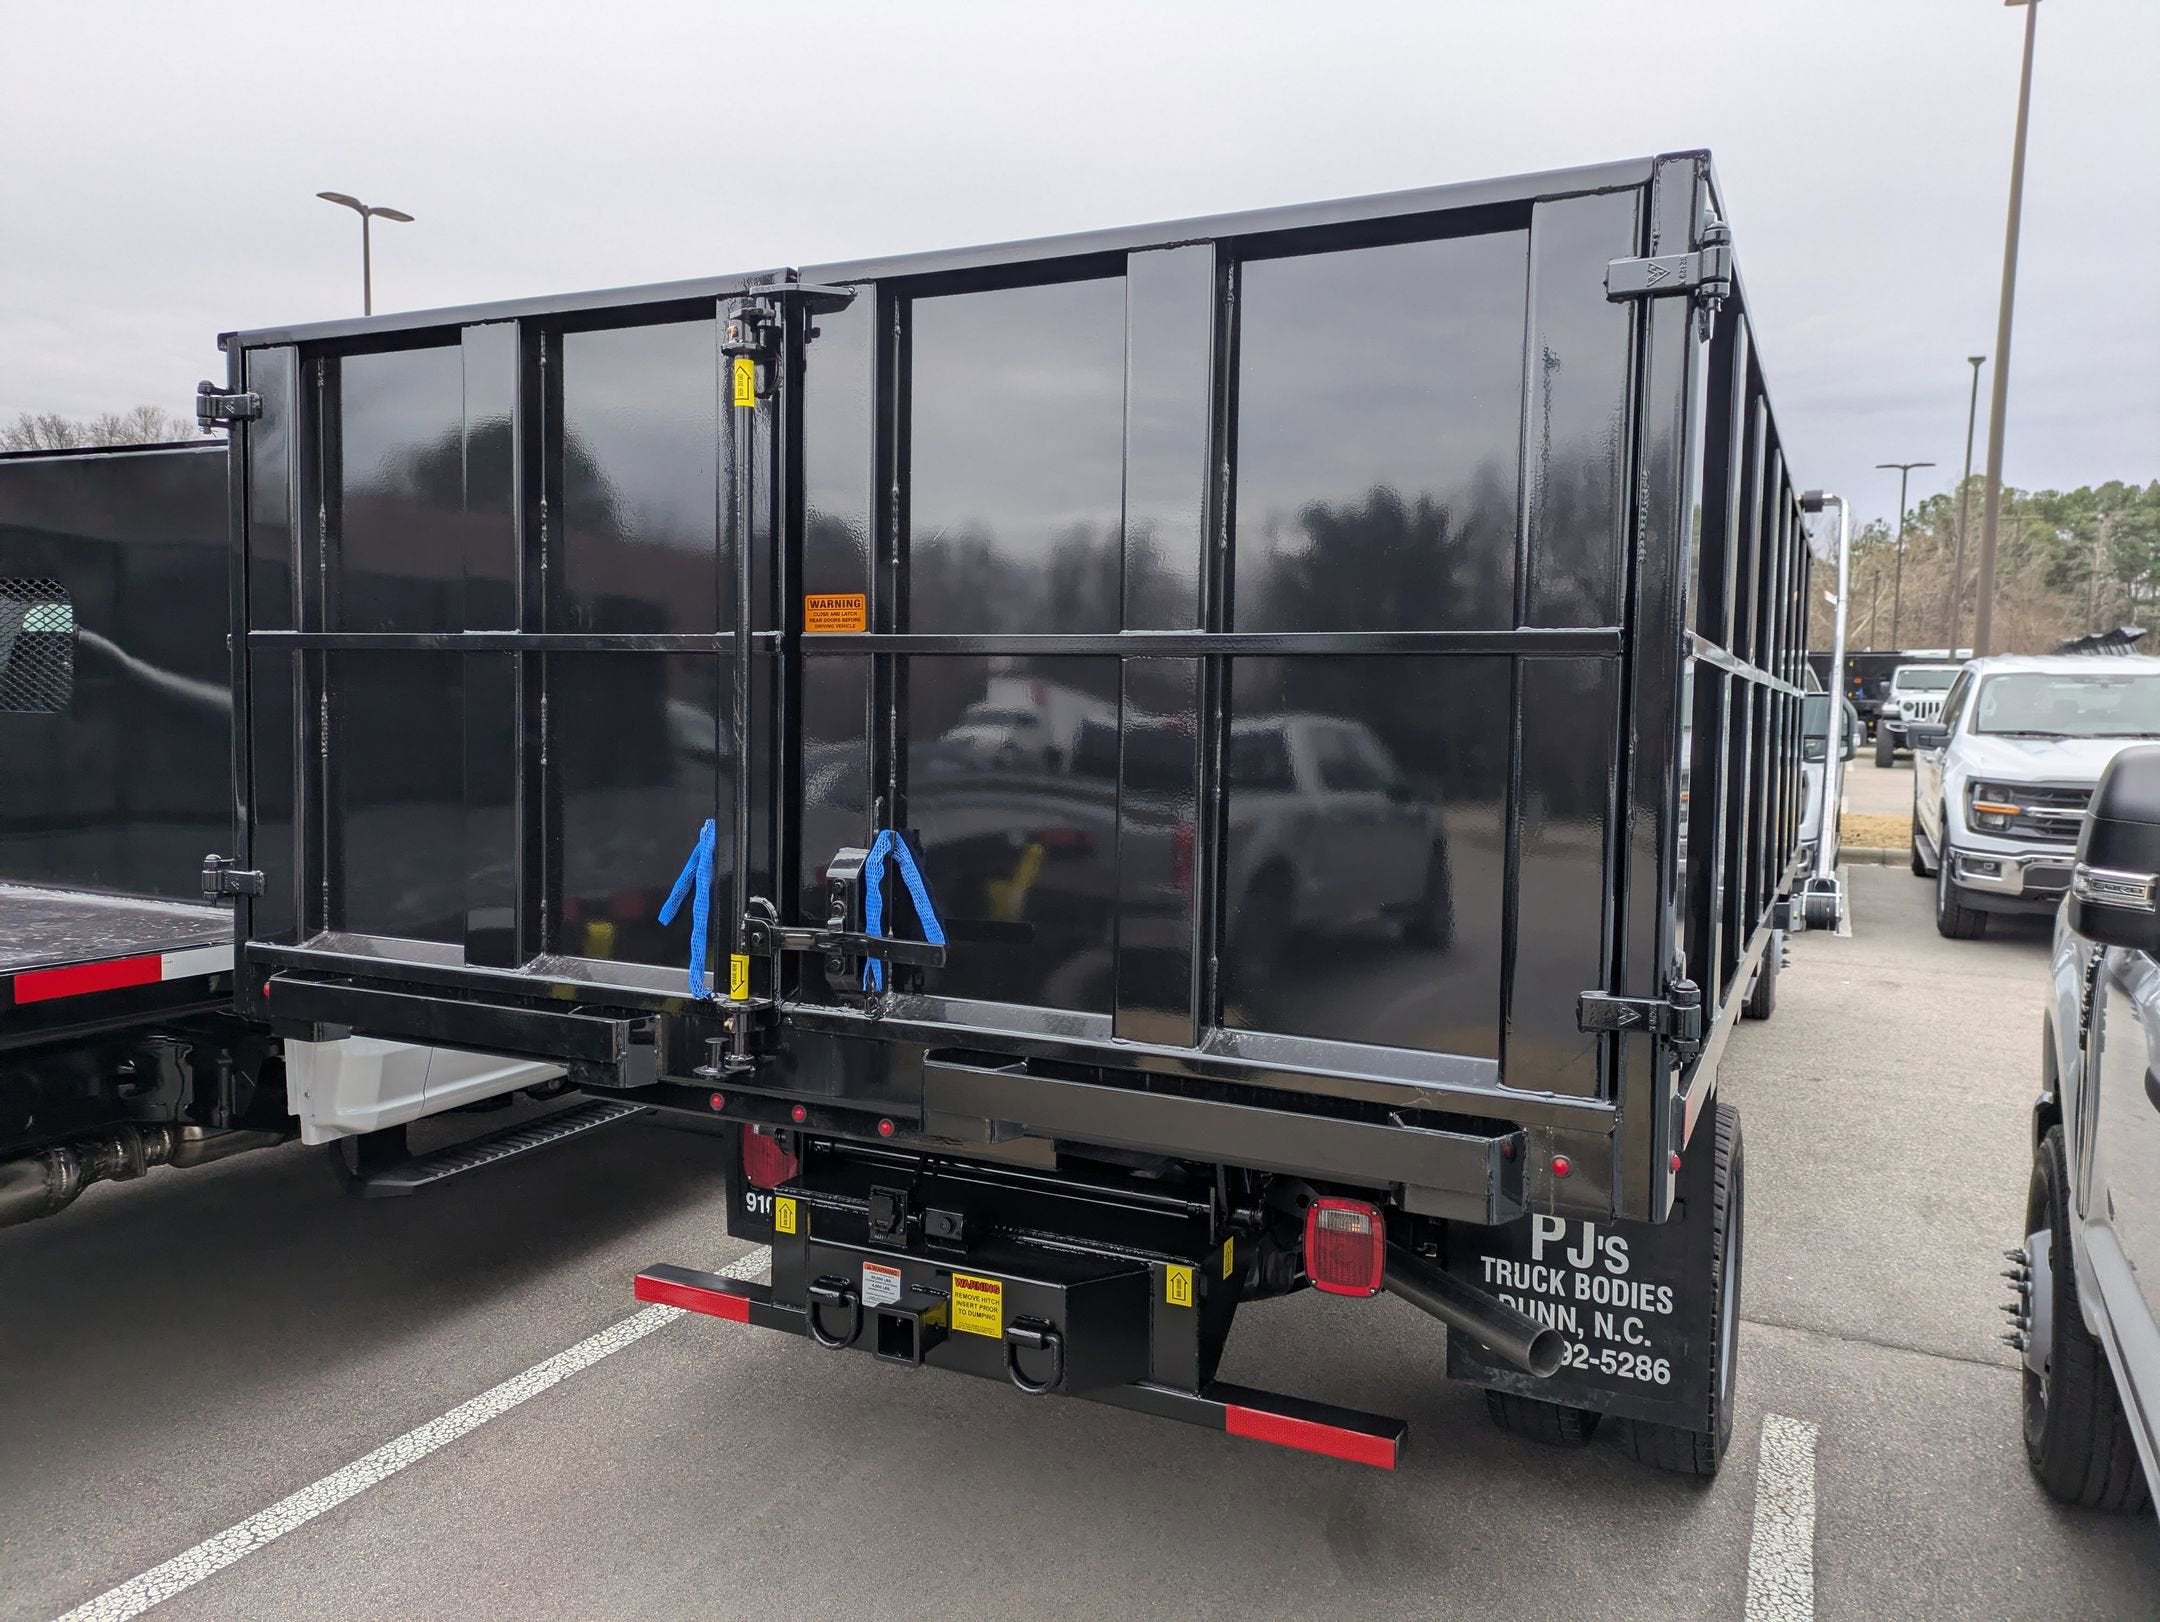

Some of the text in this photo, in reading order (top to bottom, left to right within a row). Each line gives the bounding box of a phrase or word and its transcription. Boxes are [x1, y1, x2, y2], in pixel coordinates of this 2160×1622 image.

[809, 599, 861, 609] WARNING
[1531, 1213, 1630, 1275] PJ'S
[954, 1276, 1000, 1294] WARNING
[1480, 1256, 1674, 1315] TRUCK BODIES
[954, 1291, 1000, 1305] REMOVE HITCH
[956, 1300, 998, 1313] INSERT PRIOR
[958, 1308, 996, 1321] TO DUMPING
[1594, 1310, 1652, 1347] N.C.
